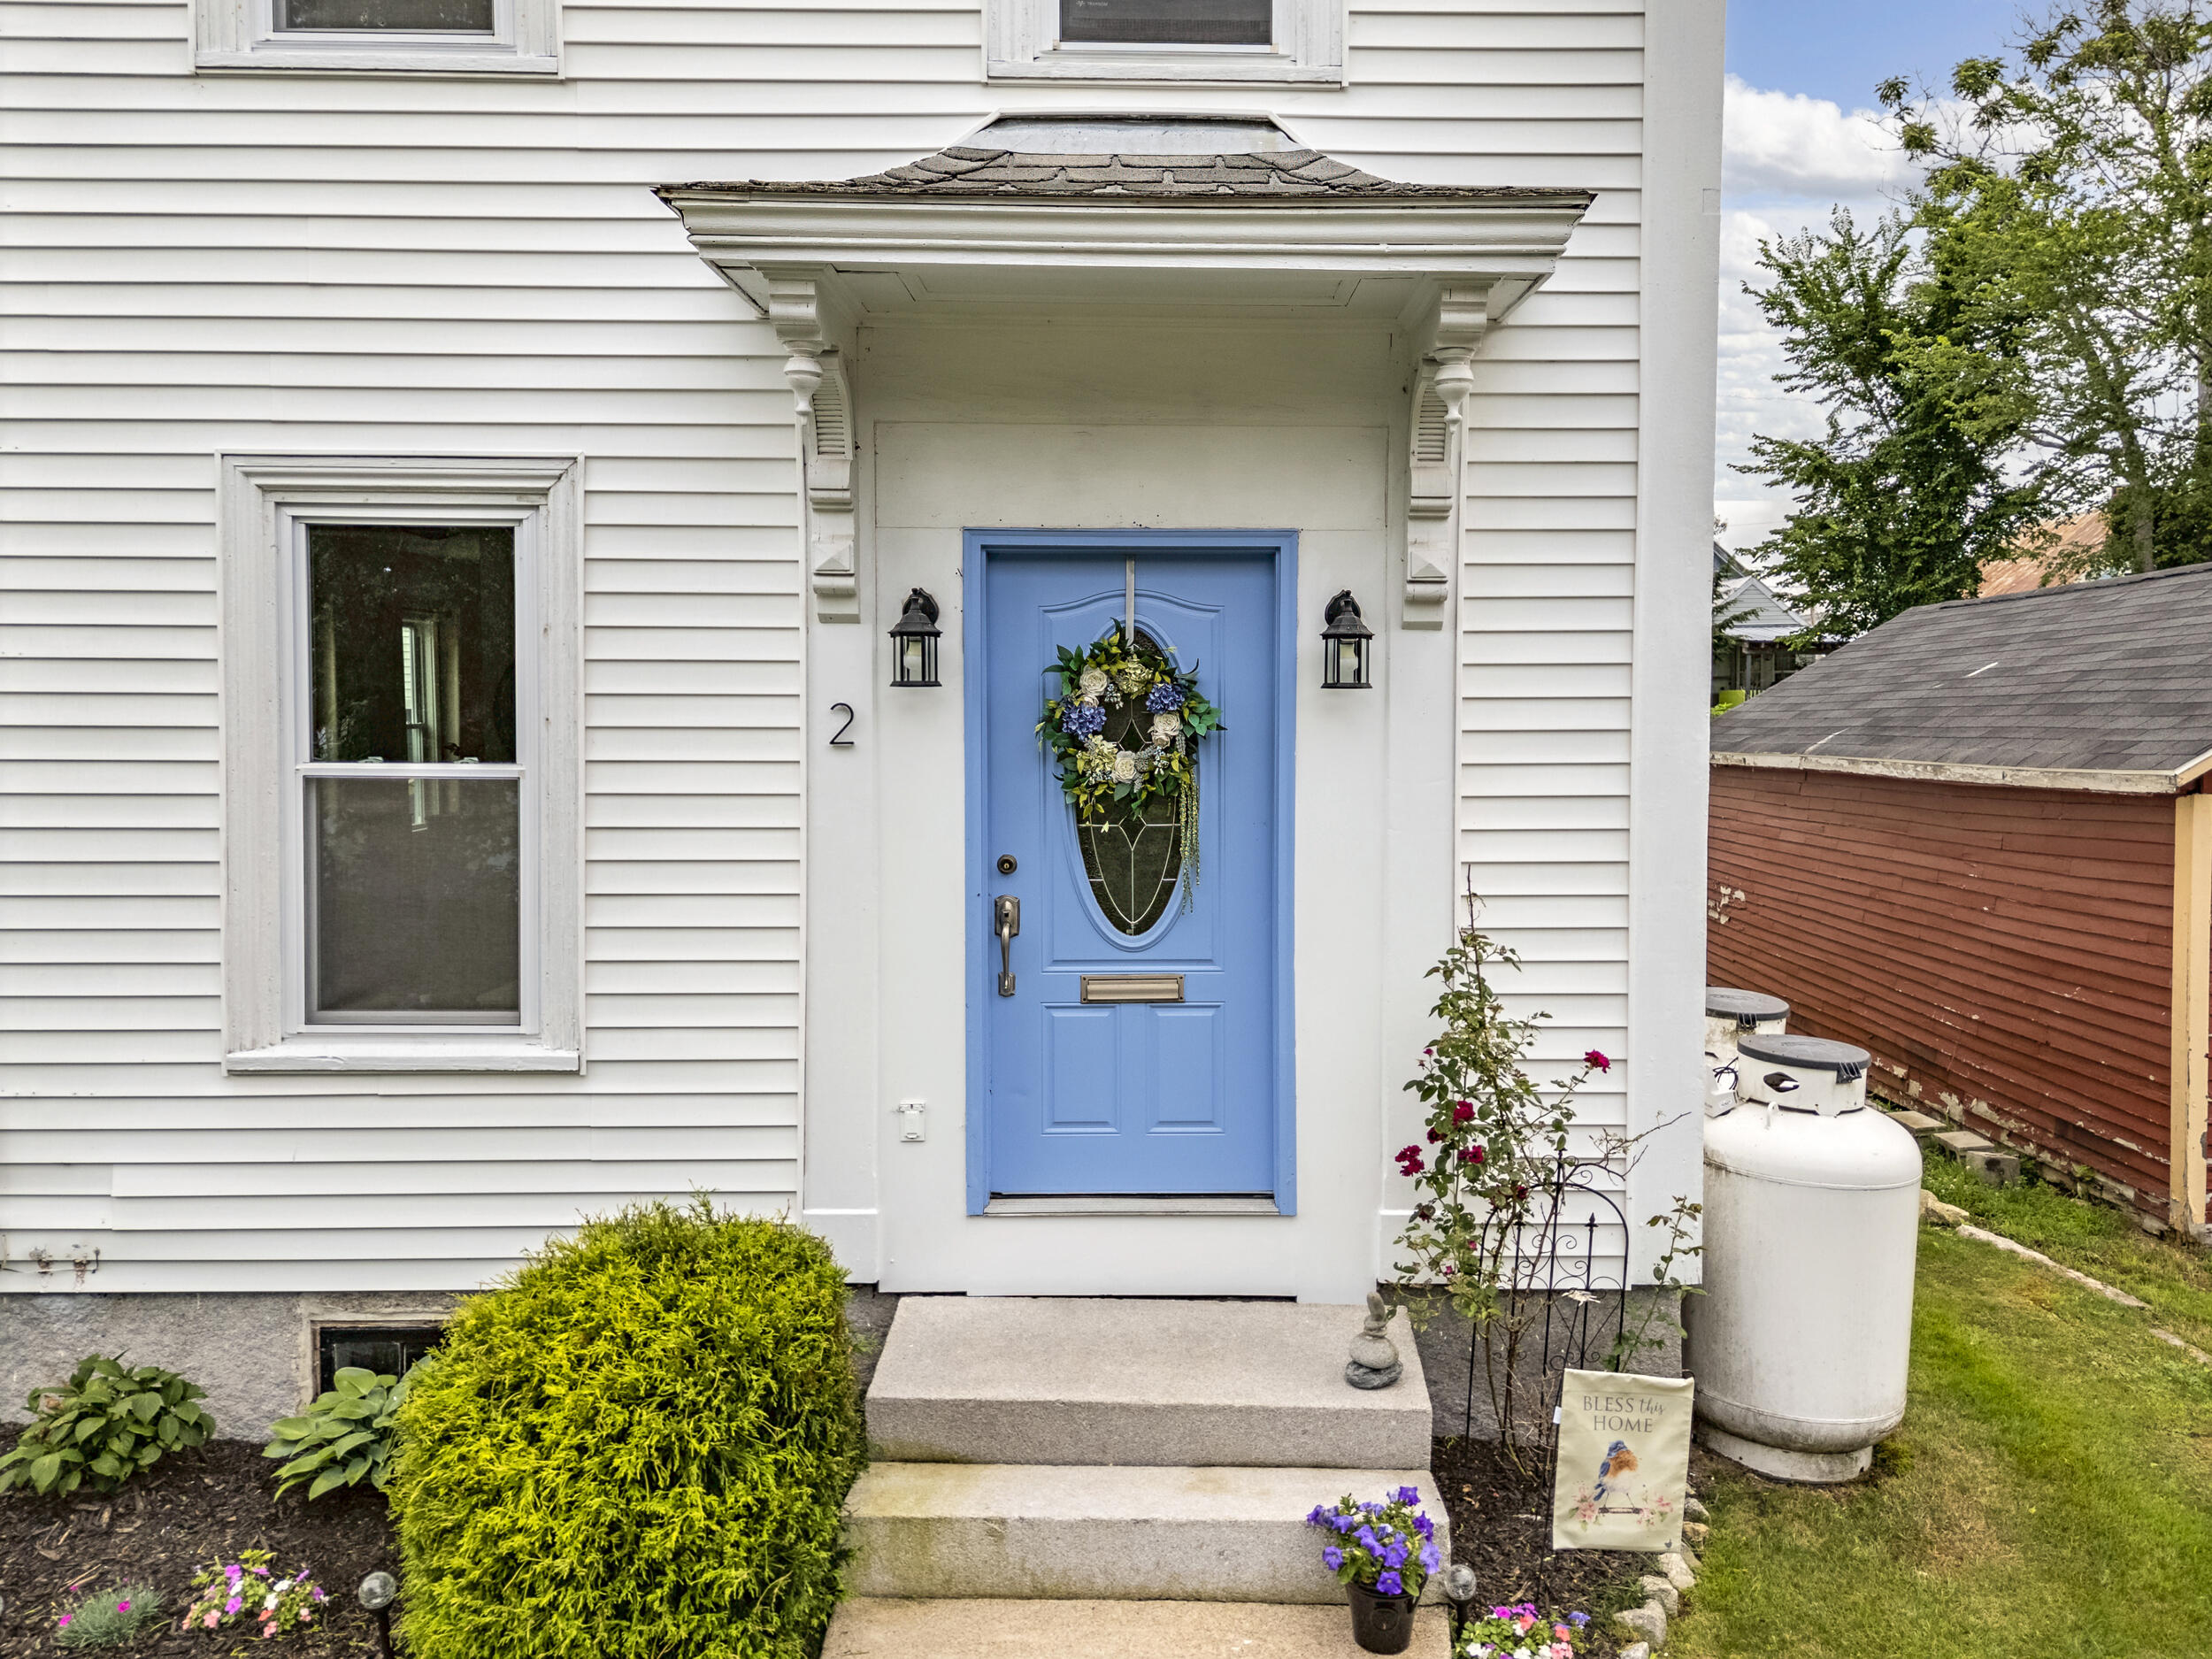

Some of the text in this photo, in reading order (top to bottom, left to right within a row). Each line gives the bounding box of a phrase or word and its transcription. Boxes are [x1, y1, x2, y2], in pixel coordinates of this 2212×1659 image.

[829, 703, 855, 744] 2
[1583, 1395, 1665, 1415] BLESS this
[1594, 1415, 1653, 1432] HOME
